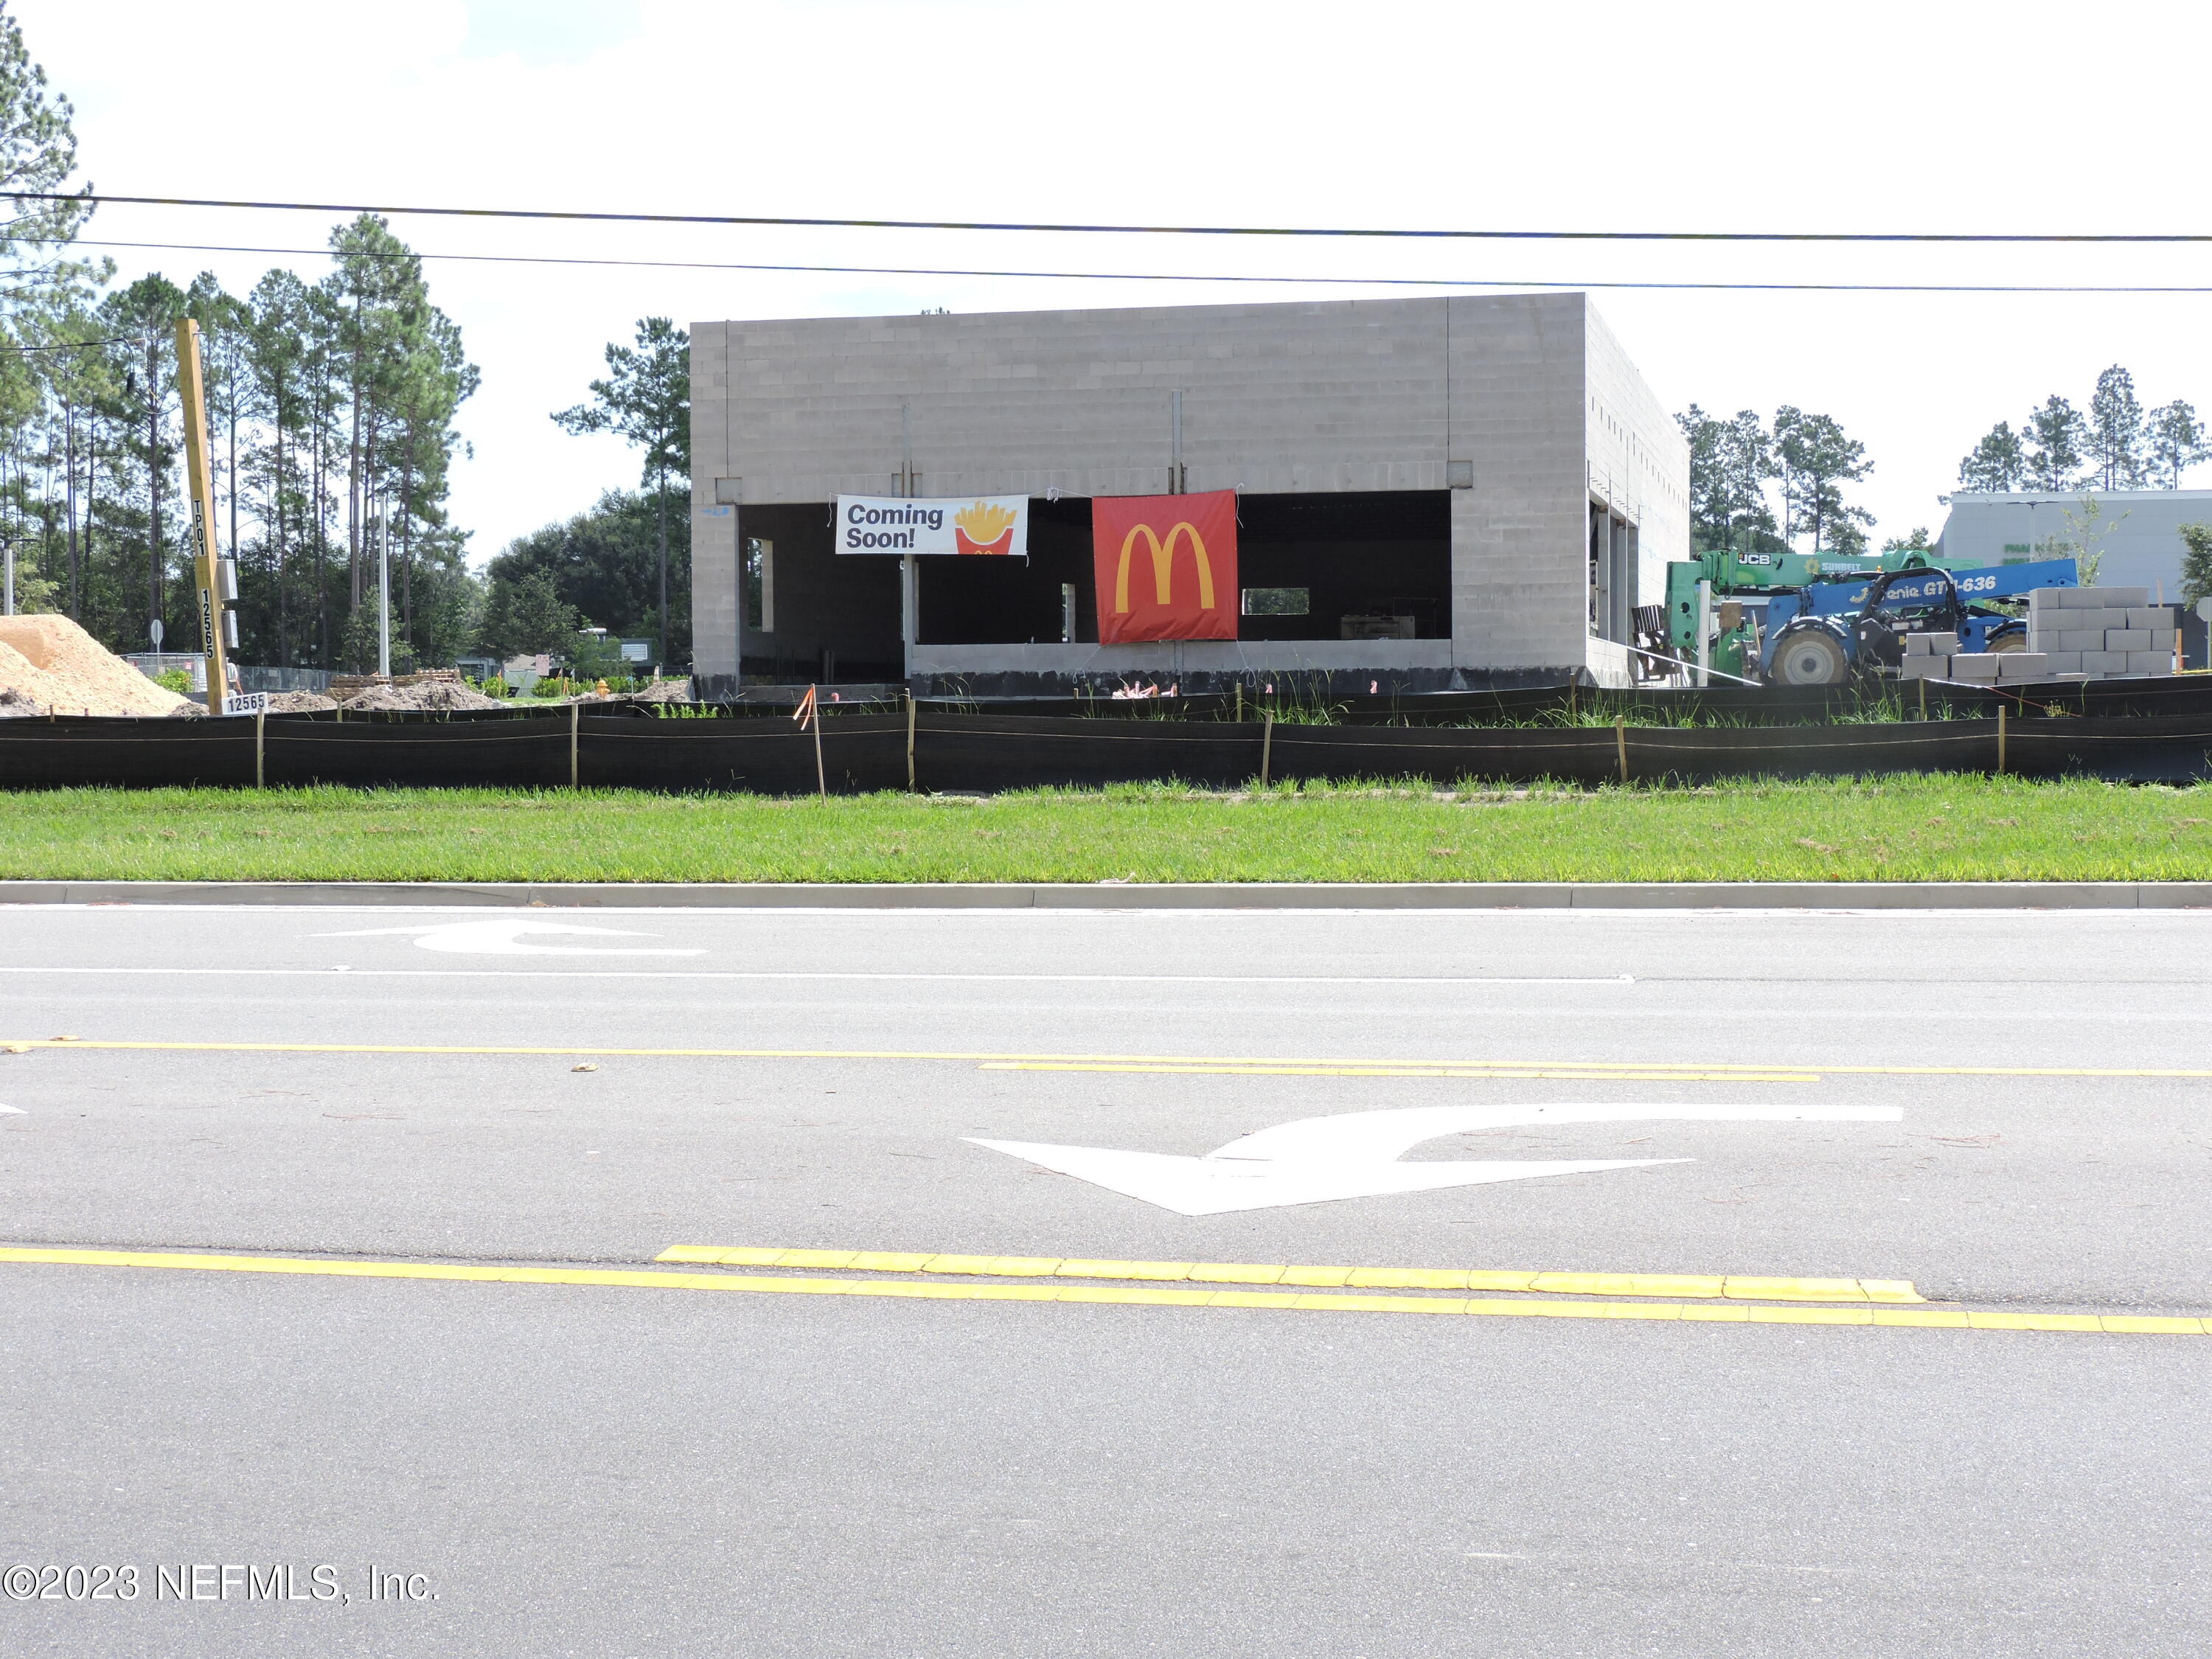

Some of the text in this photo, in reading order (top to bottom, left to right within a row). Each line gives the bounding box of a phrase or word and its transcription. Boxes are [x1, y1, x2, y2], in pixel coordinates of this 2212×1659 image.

[848, 504, 943, 531] Coming
[846, 527, 915, 549] Soon!
[1738, 554, 1770, 565] JCB
[1821, 563, 1862, 571] SUNBELT
[203, 589, 213, 658] 12565
[228, 695, 265, 712] 12565
